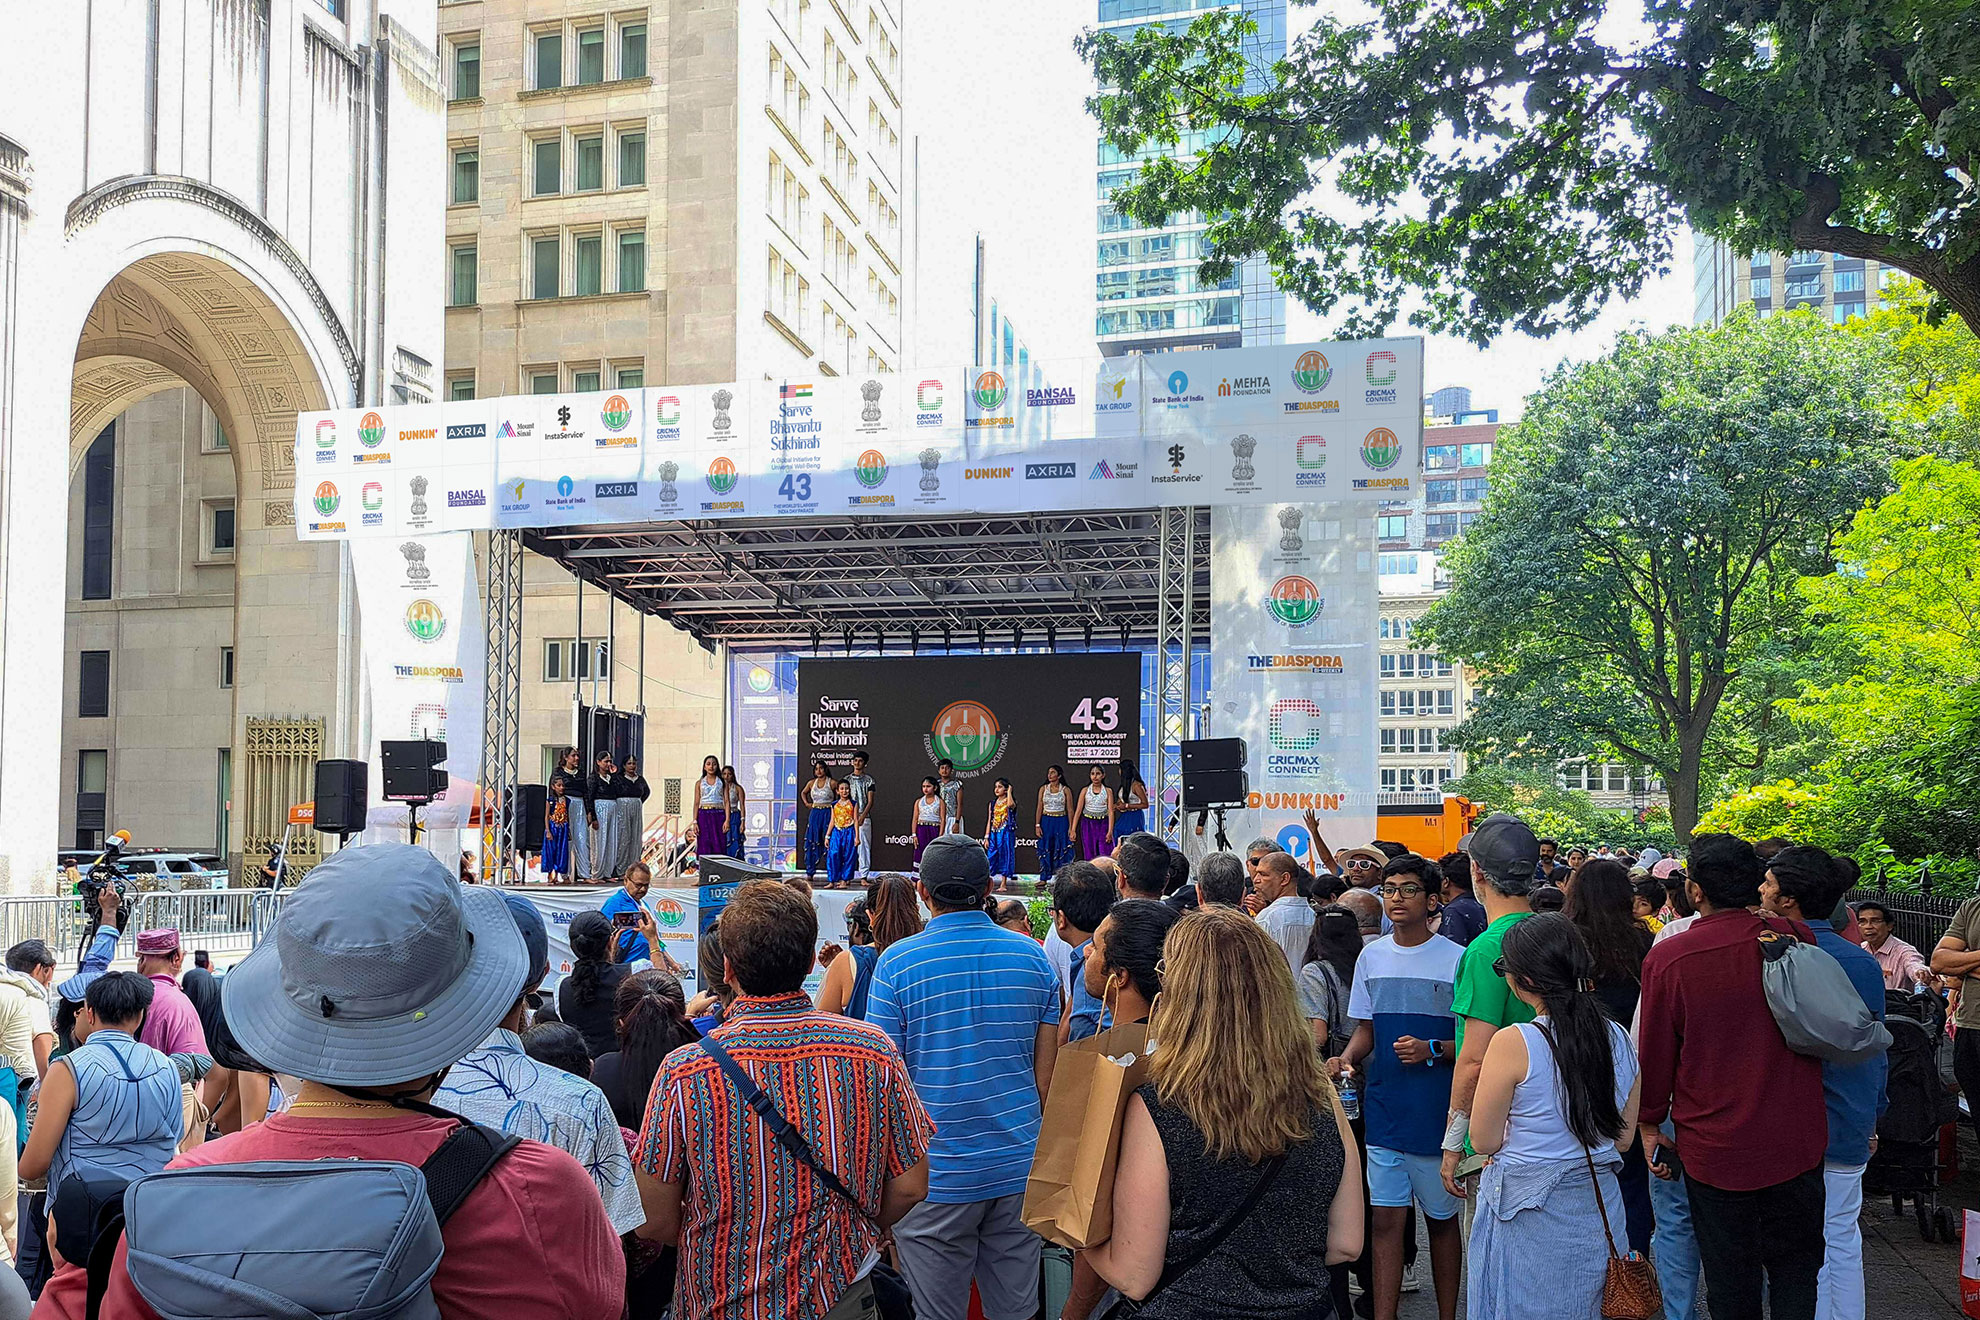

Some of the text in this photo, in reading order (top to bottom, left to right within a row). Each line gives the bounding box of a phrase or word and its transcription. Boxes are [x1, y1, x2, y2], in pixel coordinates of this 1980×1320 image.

[1233, 376, 1271, 389] MEHTA
[1027, 387, 1075, 399] BANSAL
[1233, 388, 1271, 396] FOUNDATION
[1365, 389, 1396, 397] CRICMAX
[1027, 398, 1075, 406] FOUNDATION
[1096, 402, 1132, 411] TAK GROUP
[779, 403, 813, 418] Sarve
[447, 425, 485, 438] AXRIA
[770, 418, 822, 434] Bhavantu
[399, 429, 438, 441] DUNKIN'
[544, 431, 585, 440] InstaService
[771, 435, 821, 450] Sukhinah
[1027, 465, 1074, 477] AXRIA
[1116, 463, 1138, 471] Mount
[965, 467, 1014, 480] DUNKIN'
[1116, 471, 1134, 479] Sinai
[1151, 474, 1202, 484] InstaService
[1296, 472, 1326, 480] CRICMAX
[597, 484, 637, 496] AXRIA
[778, 473, 811, 501] 43
[448, 489, 486, 500] BANSAL
[448, 499, 486, 507] FOUNDATION
[820, 696, 859, 711] Sarve
[1070, 697, 1119, 731] 43
[810, 713, 870, 728] Bhavantu
[811, 730, 868, 745] Sukhinah
[955, 769, 980, 778] INDIAN
[981, 733, 1008, 774] ASSOCIATIONS
[1268, 755, 1320, 765] CRICMAX
[1248, 792, 1344, 811] DUNKIN'
